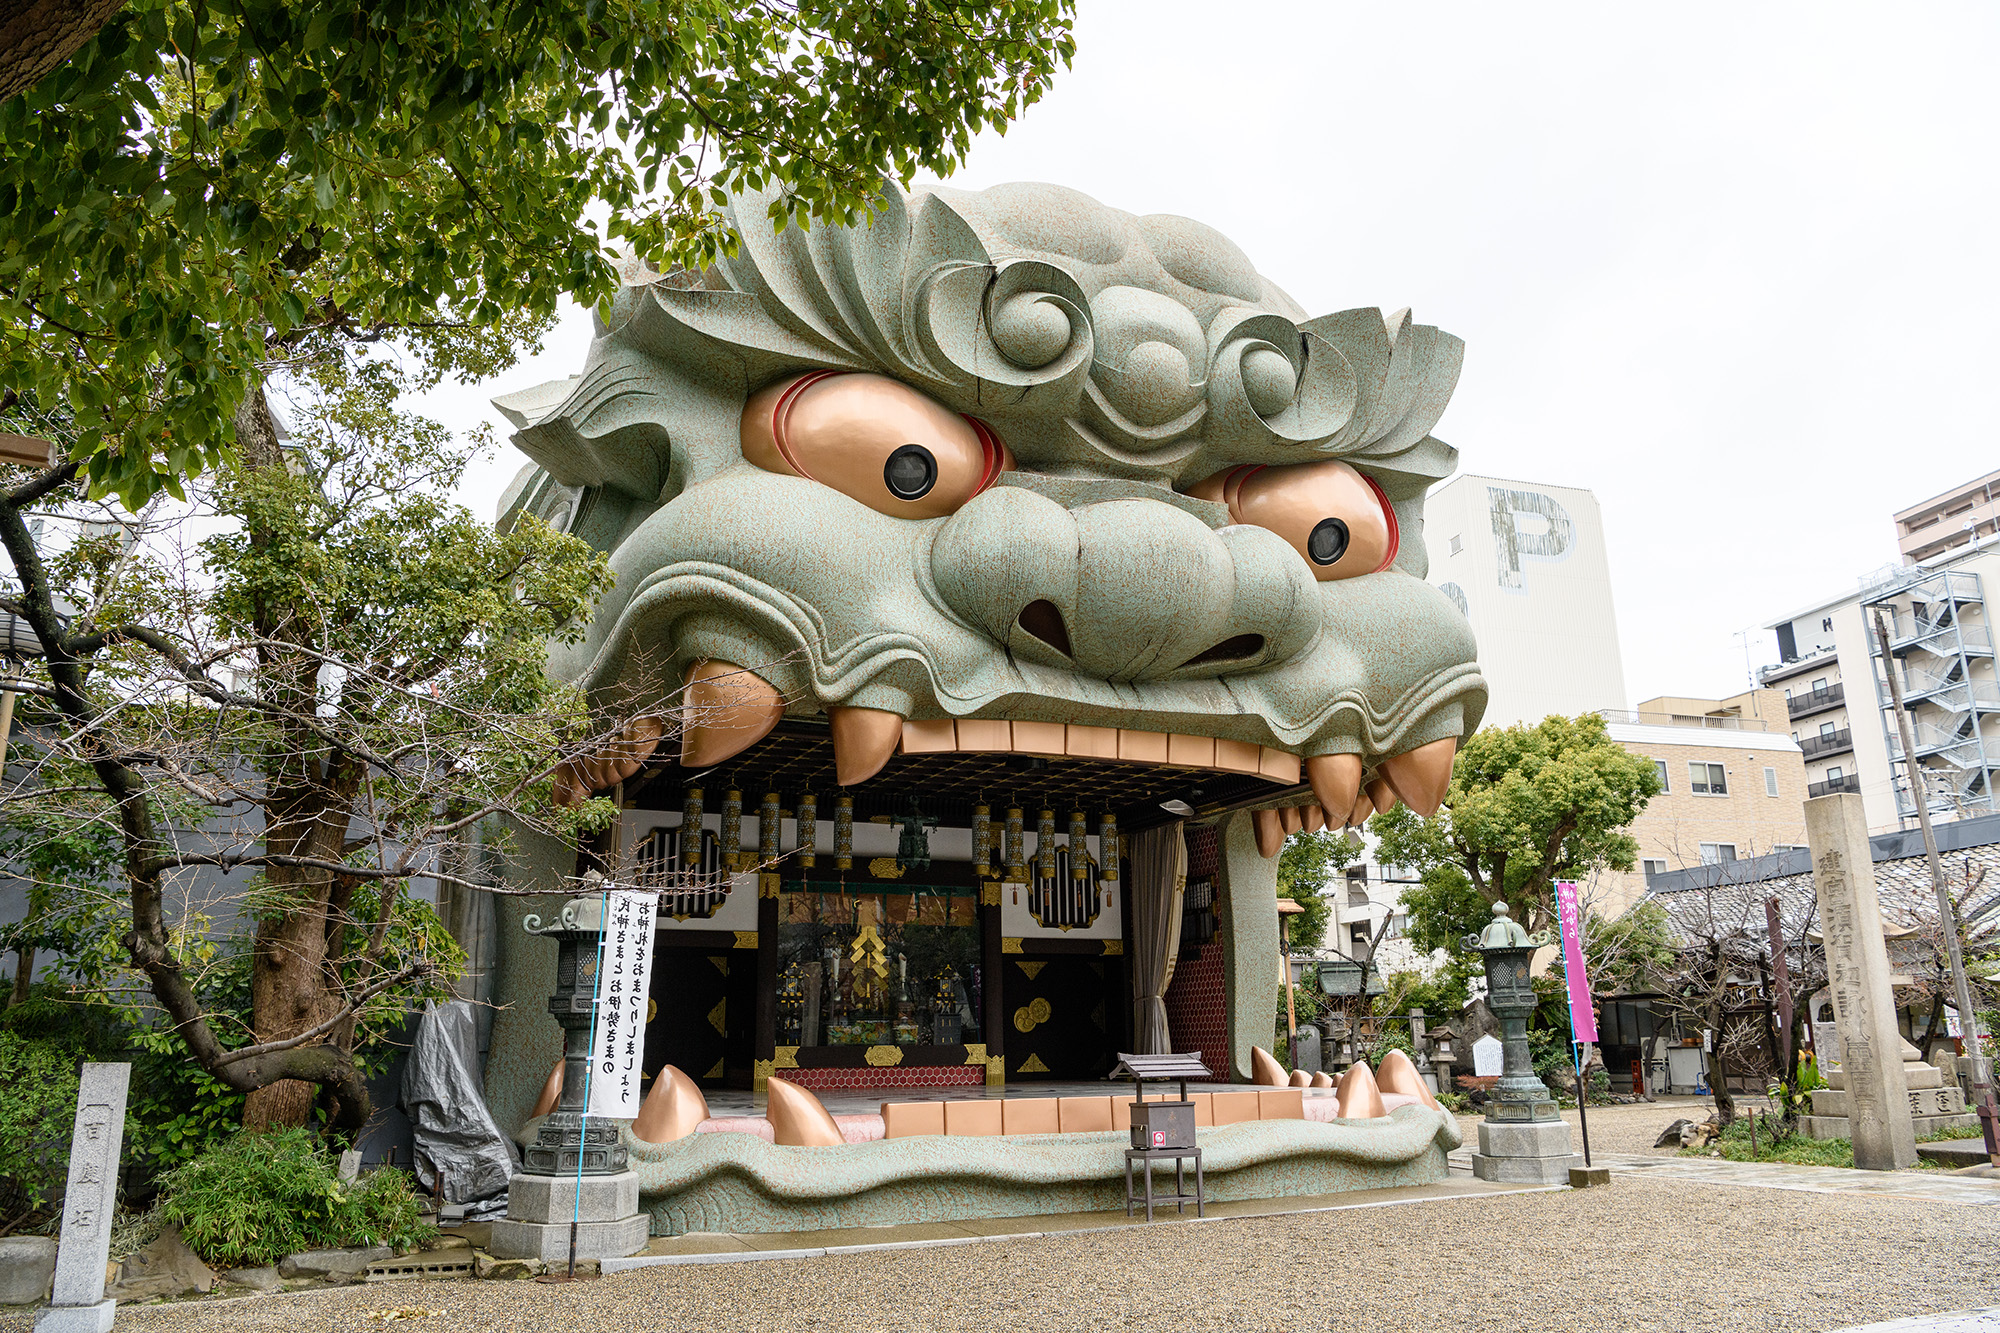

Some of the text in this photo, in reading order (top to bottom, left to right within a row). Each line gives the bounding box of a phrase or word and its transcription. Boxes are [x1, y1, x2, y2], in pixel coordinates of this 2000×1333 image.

[1487, 486, 1576, 595] P
[70, 1122, 105, 1227] 百度石
